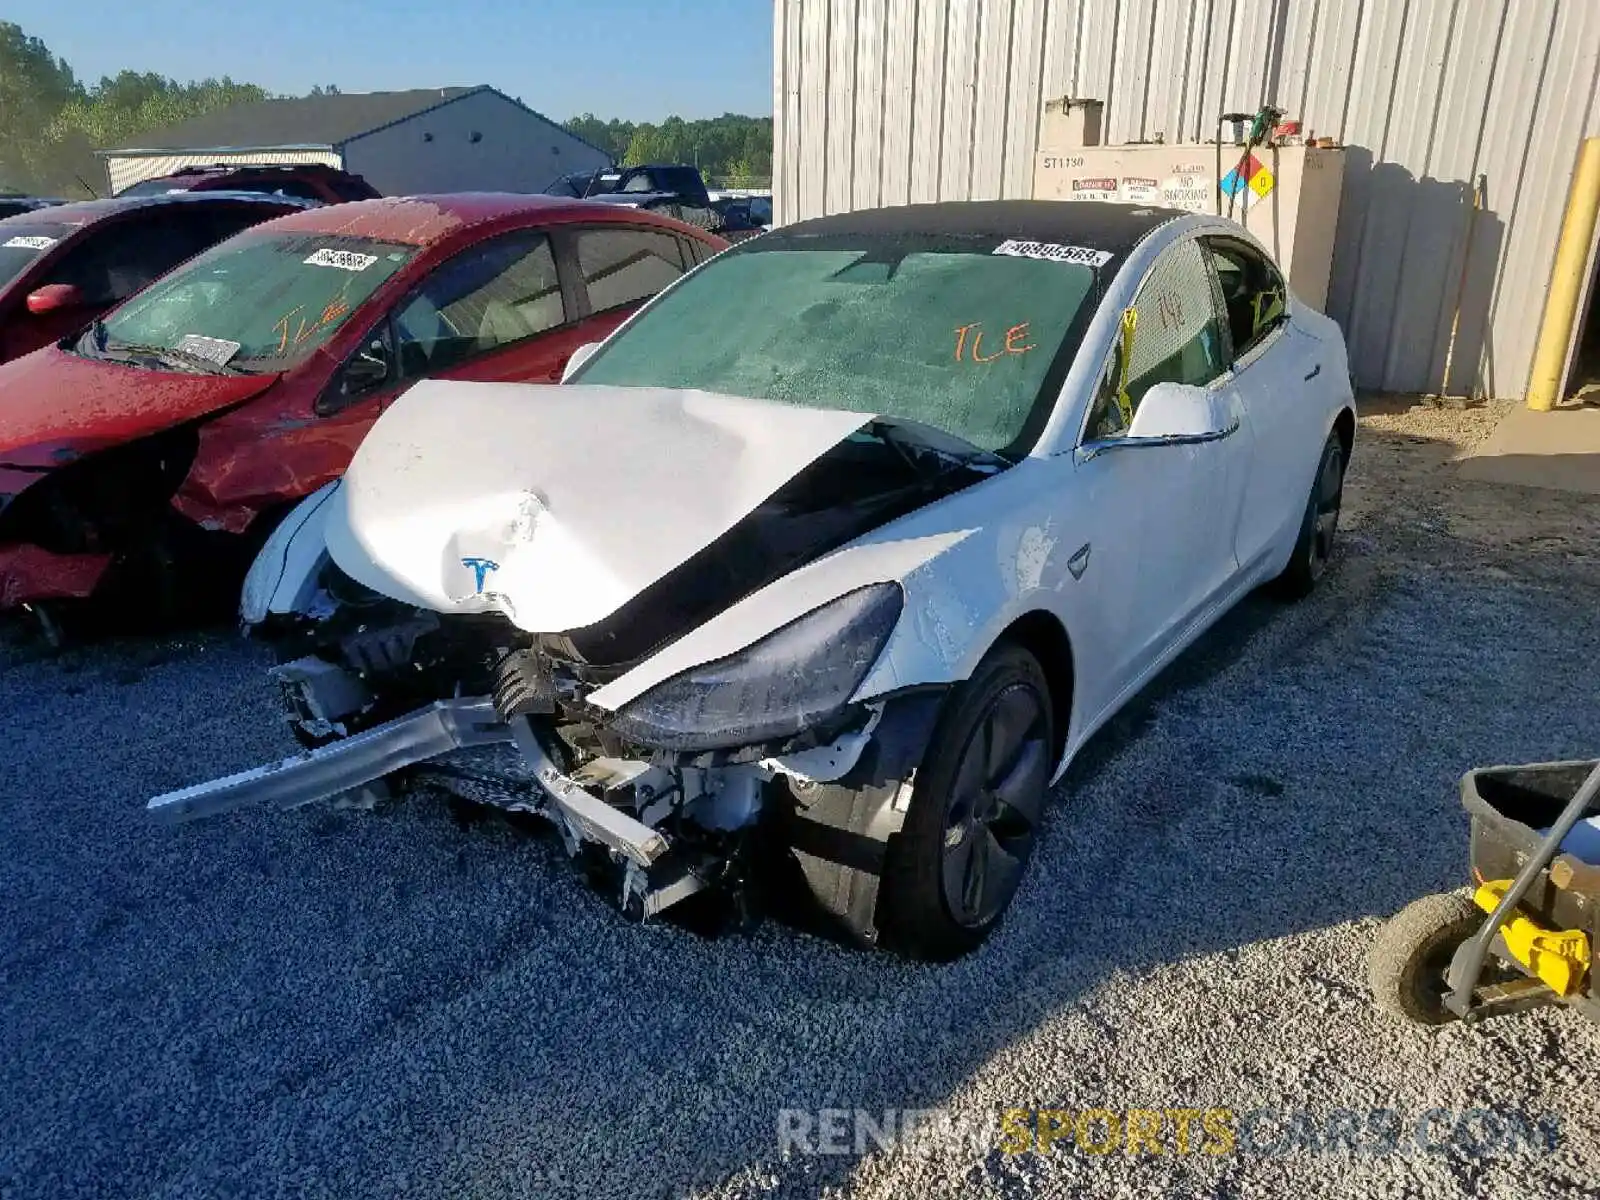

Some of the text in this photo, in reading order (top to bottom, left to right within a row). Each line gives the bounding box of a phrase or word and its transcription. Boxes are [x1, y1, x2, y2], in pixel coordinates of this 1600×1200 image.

[1180, 177, 1194, 188] NO
[1164, 188, 1208, 201] SMOKING
[954, 321, 1037, 362] TLE
